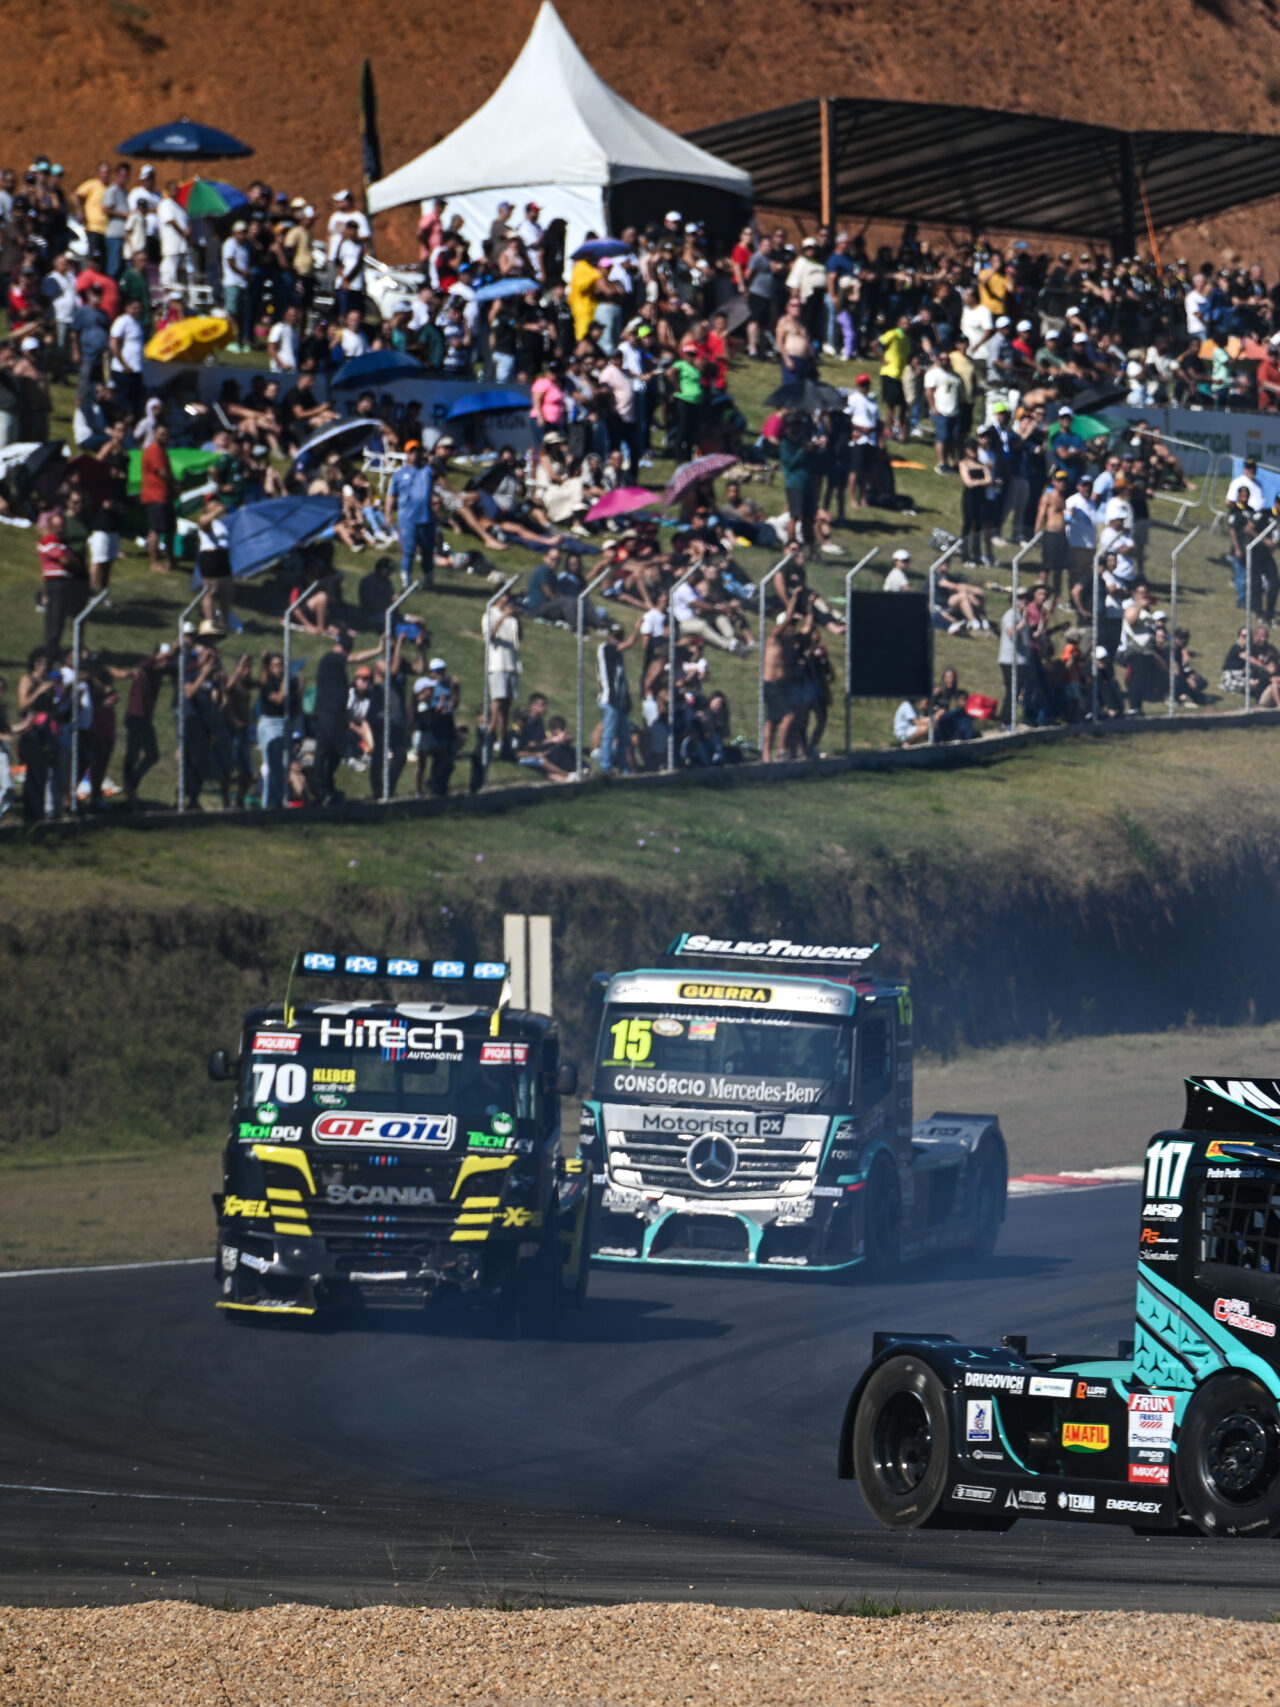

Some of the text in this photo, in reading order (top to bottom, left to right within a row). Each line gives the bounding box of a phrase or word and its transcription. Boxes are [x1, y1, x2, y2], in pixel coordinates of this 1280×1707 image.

[683, 985, 767, 1002] GUERRA
[256, 1037, 298, 1050] PIQUERI
[611, 1019, 653, 1062] 15
[407, 1051, 464, 1062] AUTOMOTIVE
[252, 1063, 307, 1104] 70
[614, 1073, 705, 1096] CONSÓRCIO
[643, 1113, 749, 1135] Motorista
[1146, 1141, 1195, 1198] 117
[327, 1184, 436, 1206] SCANIA
[965, 1372, 1025, 1389] DRUGOVICH
[1130, 1395, 1172, 1412] FRUM
[1063, 1425, 1107, 1444] AMAFIL
